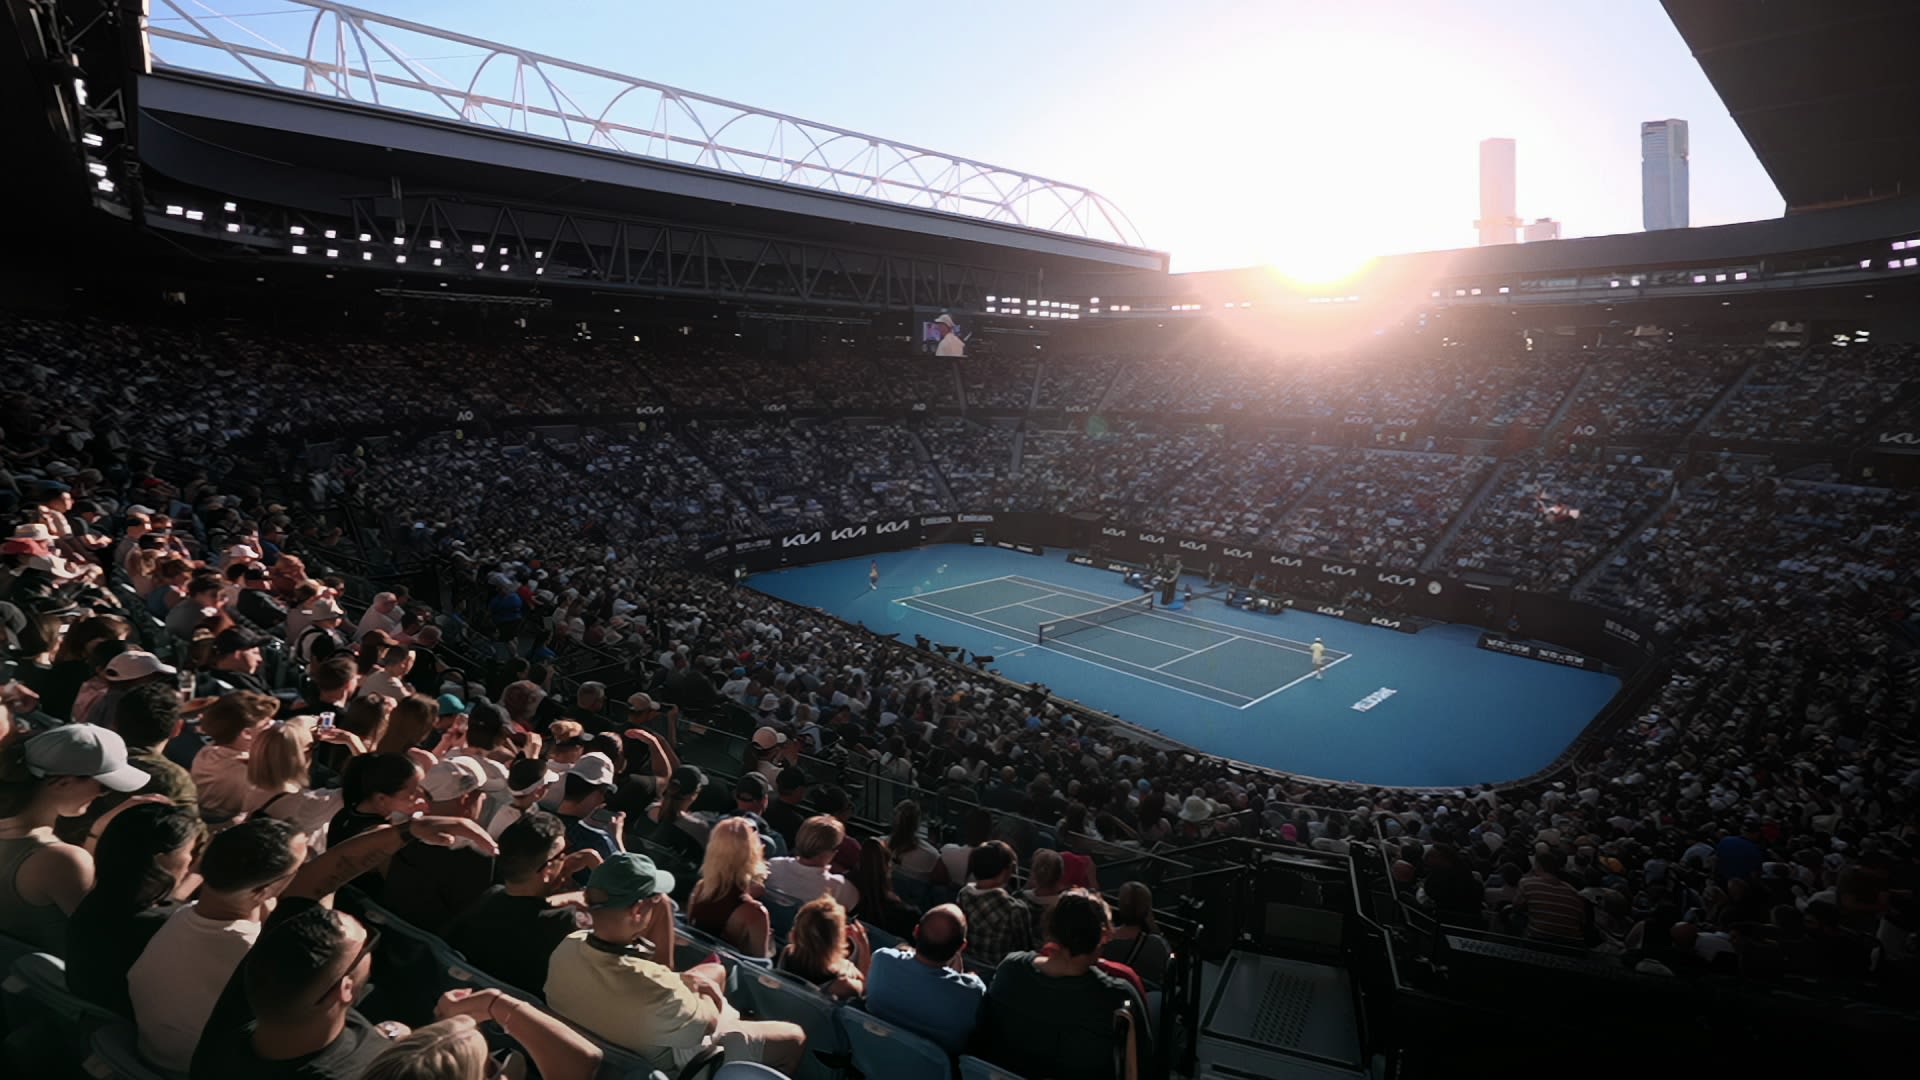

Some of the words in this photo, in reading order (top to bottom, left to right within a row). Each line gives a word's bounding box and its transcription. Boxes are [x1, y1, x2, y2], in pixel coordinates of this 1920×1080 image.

[831, 525, 867, 541] KIA
[876, 519, 910, 534] KIA
[782, 531, 821, 548] KIA
[1271, 555, 1303, 567] KIA
[1321, 564, 1357, 576] KIA
[1377, 573, 1416, 586] KIA
[1371, 616, 1401, 628] KIA
